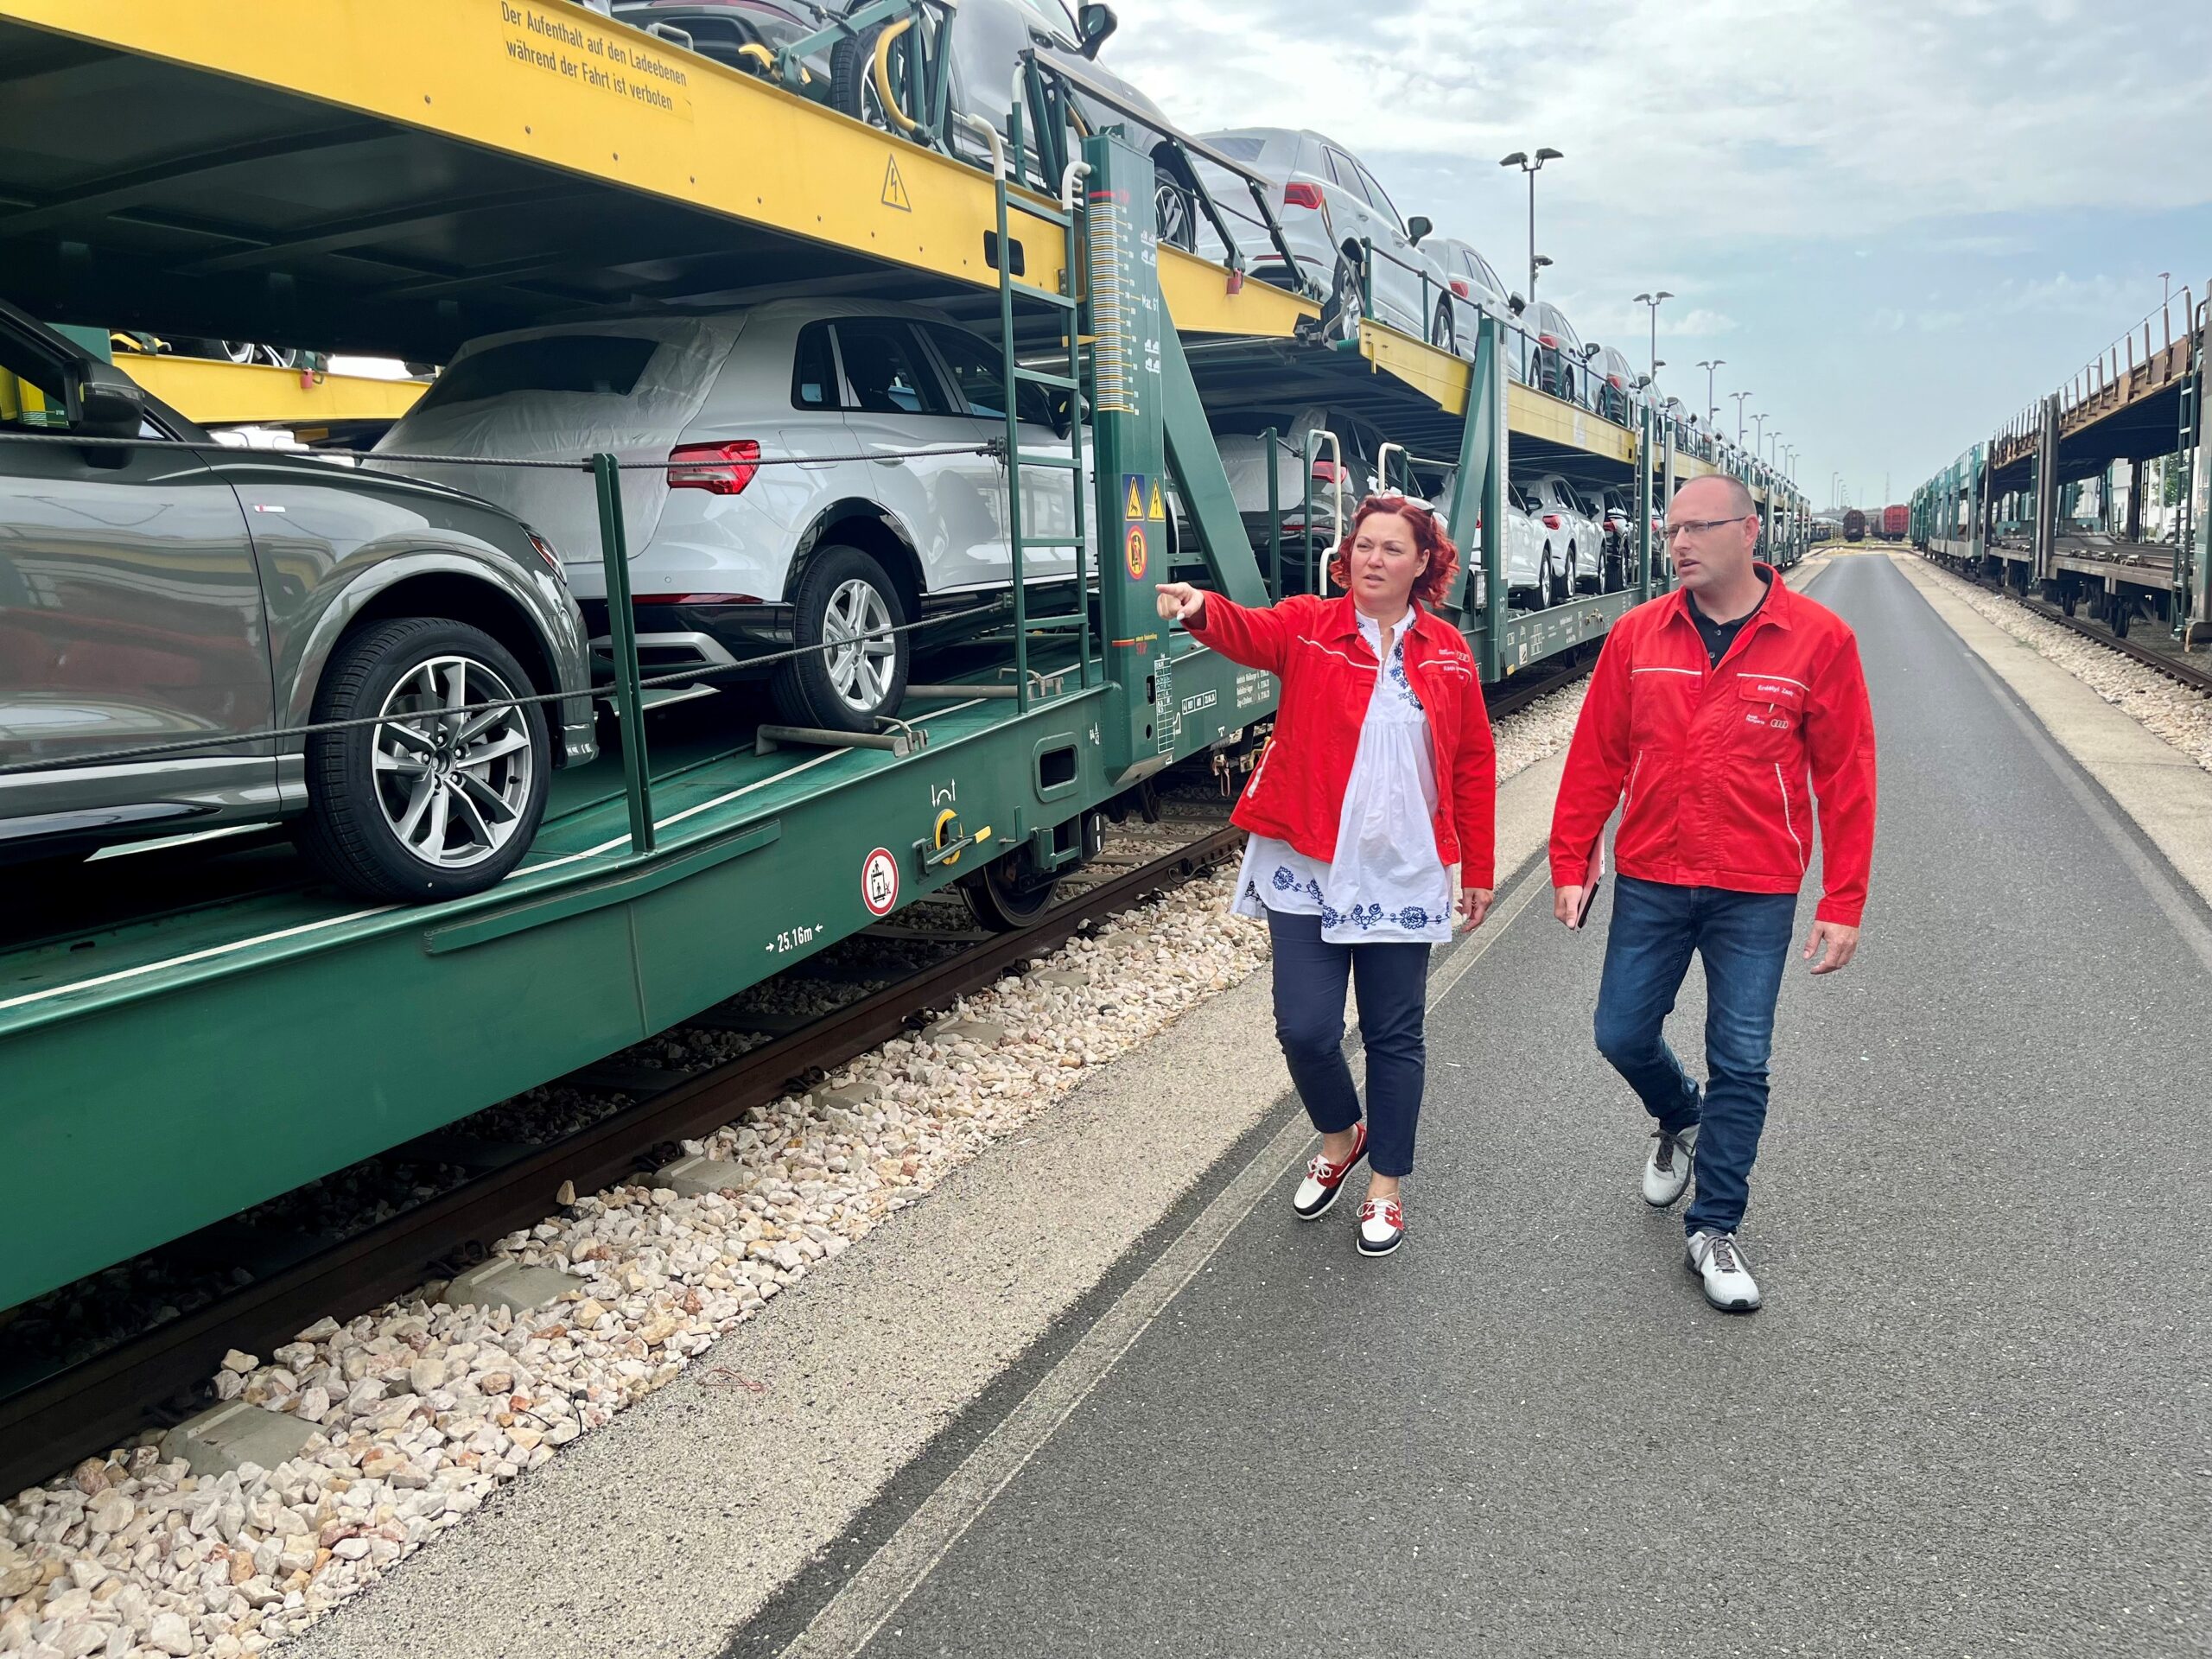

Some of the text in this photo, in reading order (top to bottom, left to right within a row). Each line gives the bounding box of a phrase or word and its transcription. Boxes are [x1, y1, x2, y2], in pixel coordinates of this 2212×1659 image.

[501, 1, 687, 86] Der Aufenthalt auf den Ladeebenen
[505, 40, 673, 111] während der Fahrt ist verboten
[778, 926, 812, 953] 25,16m
